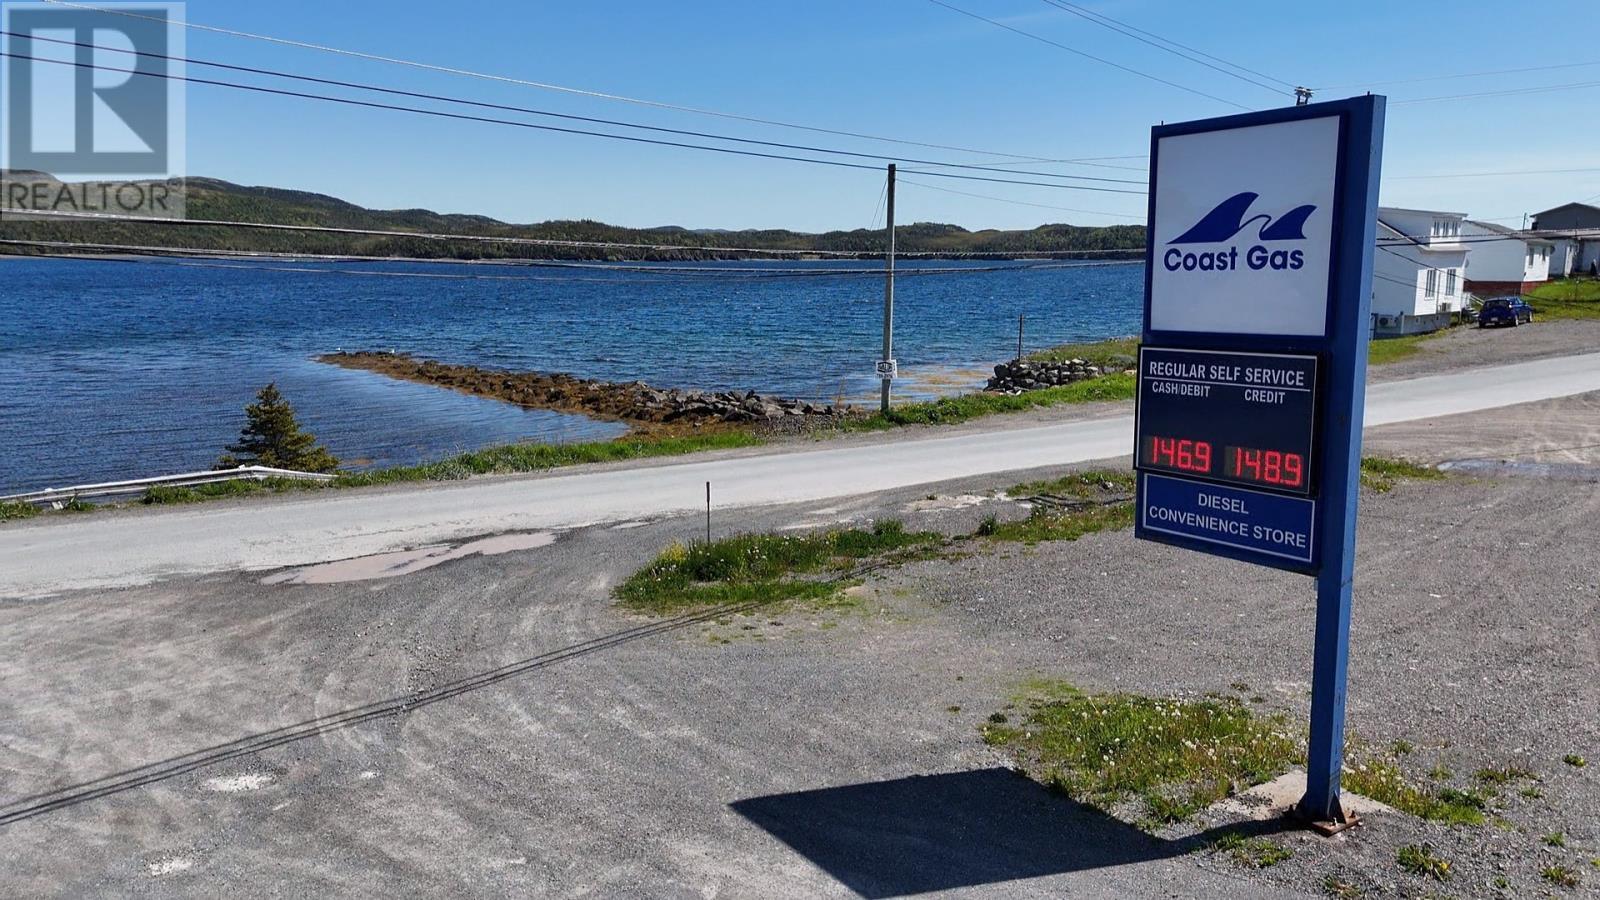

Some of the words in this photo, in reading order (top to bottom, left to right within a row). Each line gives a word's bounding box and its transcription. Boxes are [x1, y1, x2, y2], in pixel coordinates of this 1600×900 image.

[1163, 246, 1238, 271] Coast
[1246, 245, 1304, 270] Gas
[1149, 361, 1206, 379] REGULAR
[1210, 365, 1241, 381] SELF
[1245, 368, 1305, 386] SERVICE
[1152, 381, 1211, 398] CASH/DEBIT
[1244, 388, 1286, 404] CREDIT
[1198, 493, 1249, 515] DIESEL
[1149, 506, 1249, 537] CONVENIENCE
[1252, 526, 1306, 549] STORE
